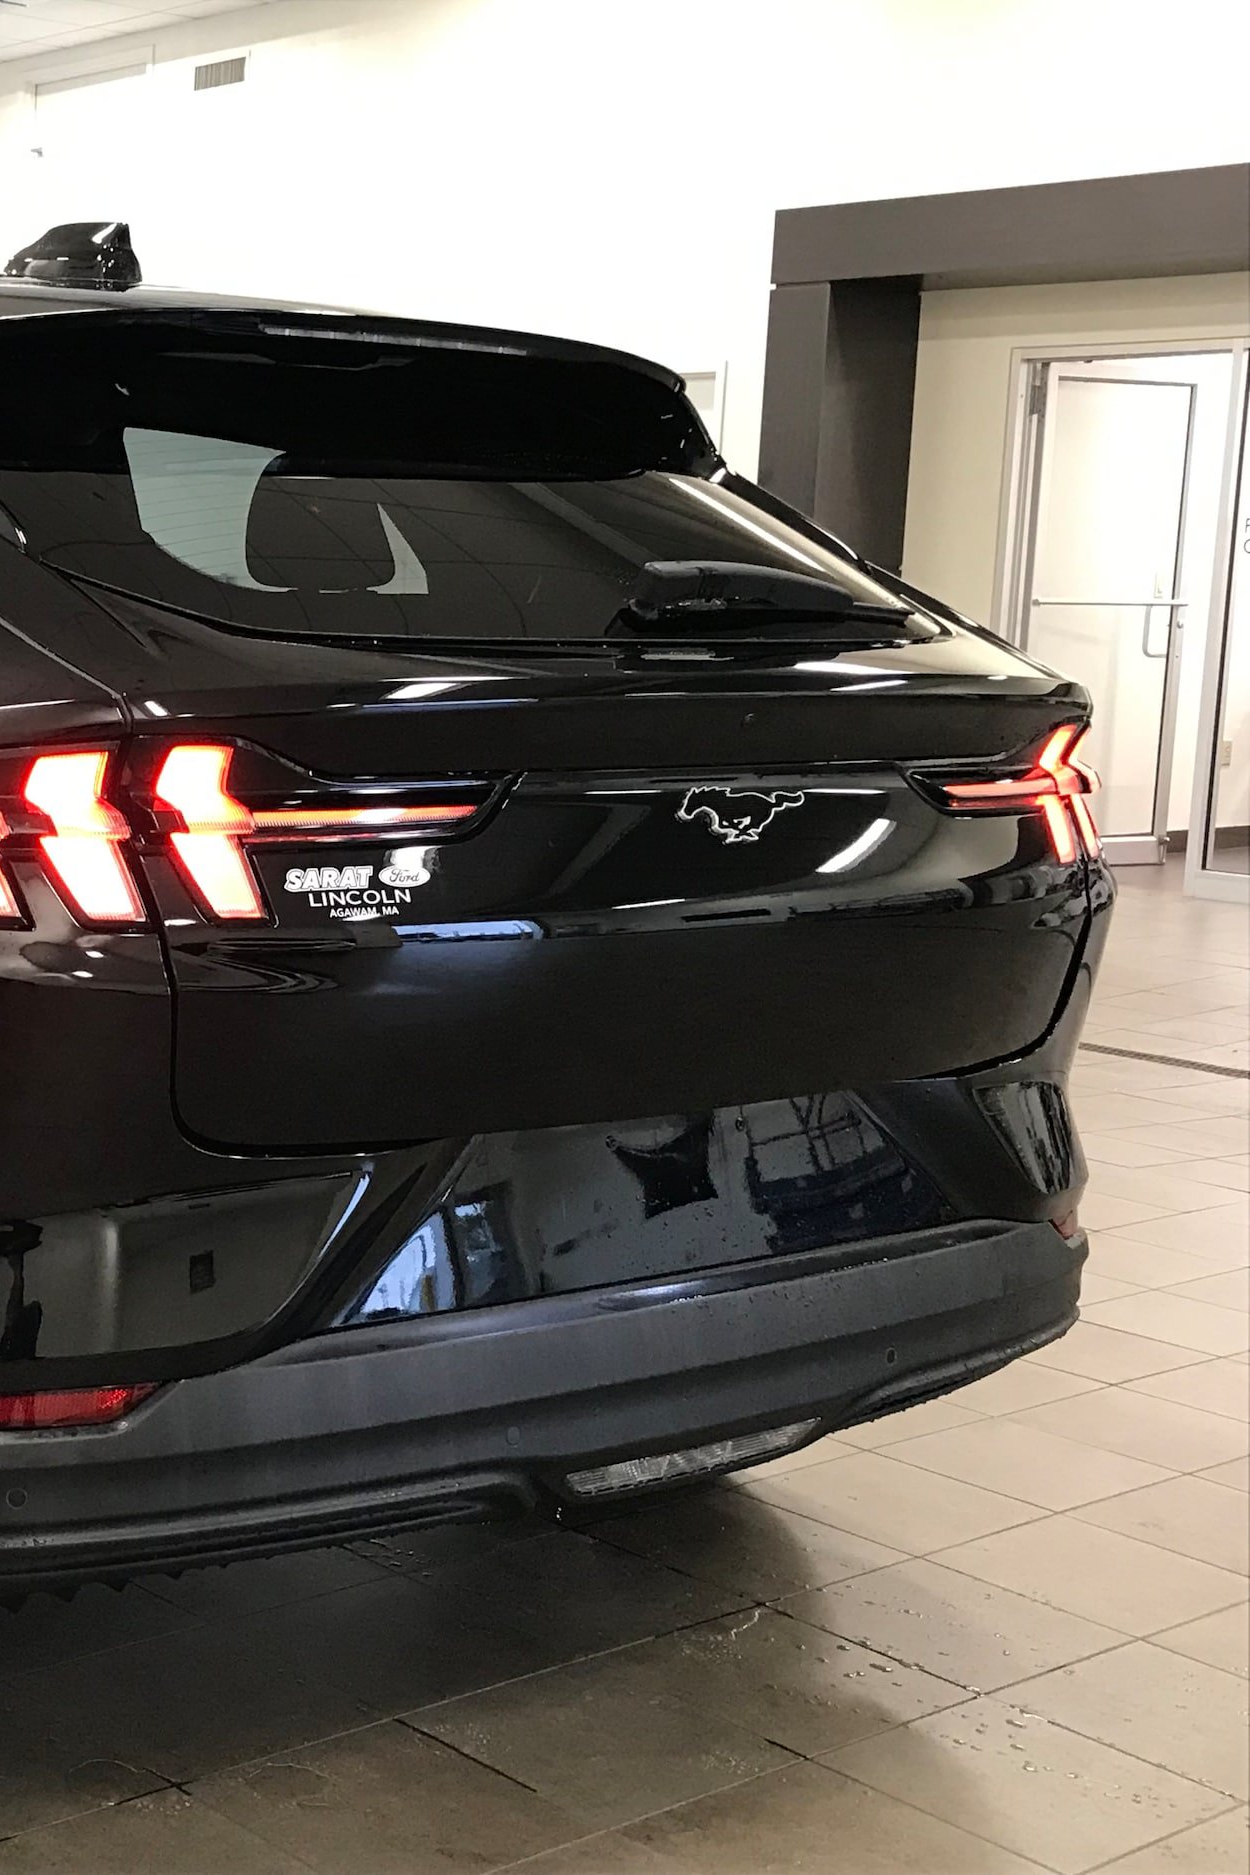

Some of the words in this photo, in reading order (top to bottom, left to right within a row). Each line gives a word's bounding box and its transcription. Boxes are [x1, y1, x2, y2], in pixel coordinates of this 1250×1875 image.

[284, 865, 373, 892] SARAT
[389, 868, 420, 883] Ford
[308, 889, 412, 907] LINCOLN
[382, 905, 400, 916] MA
